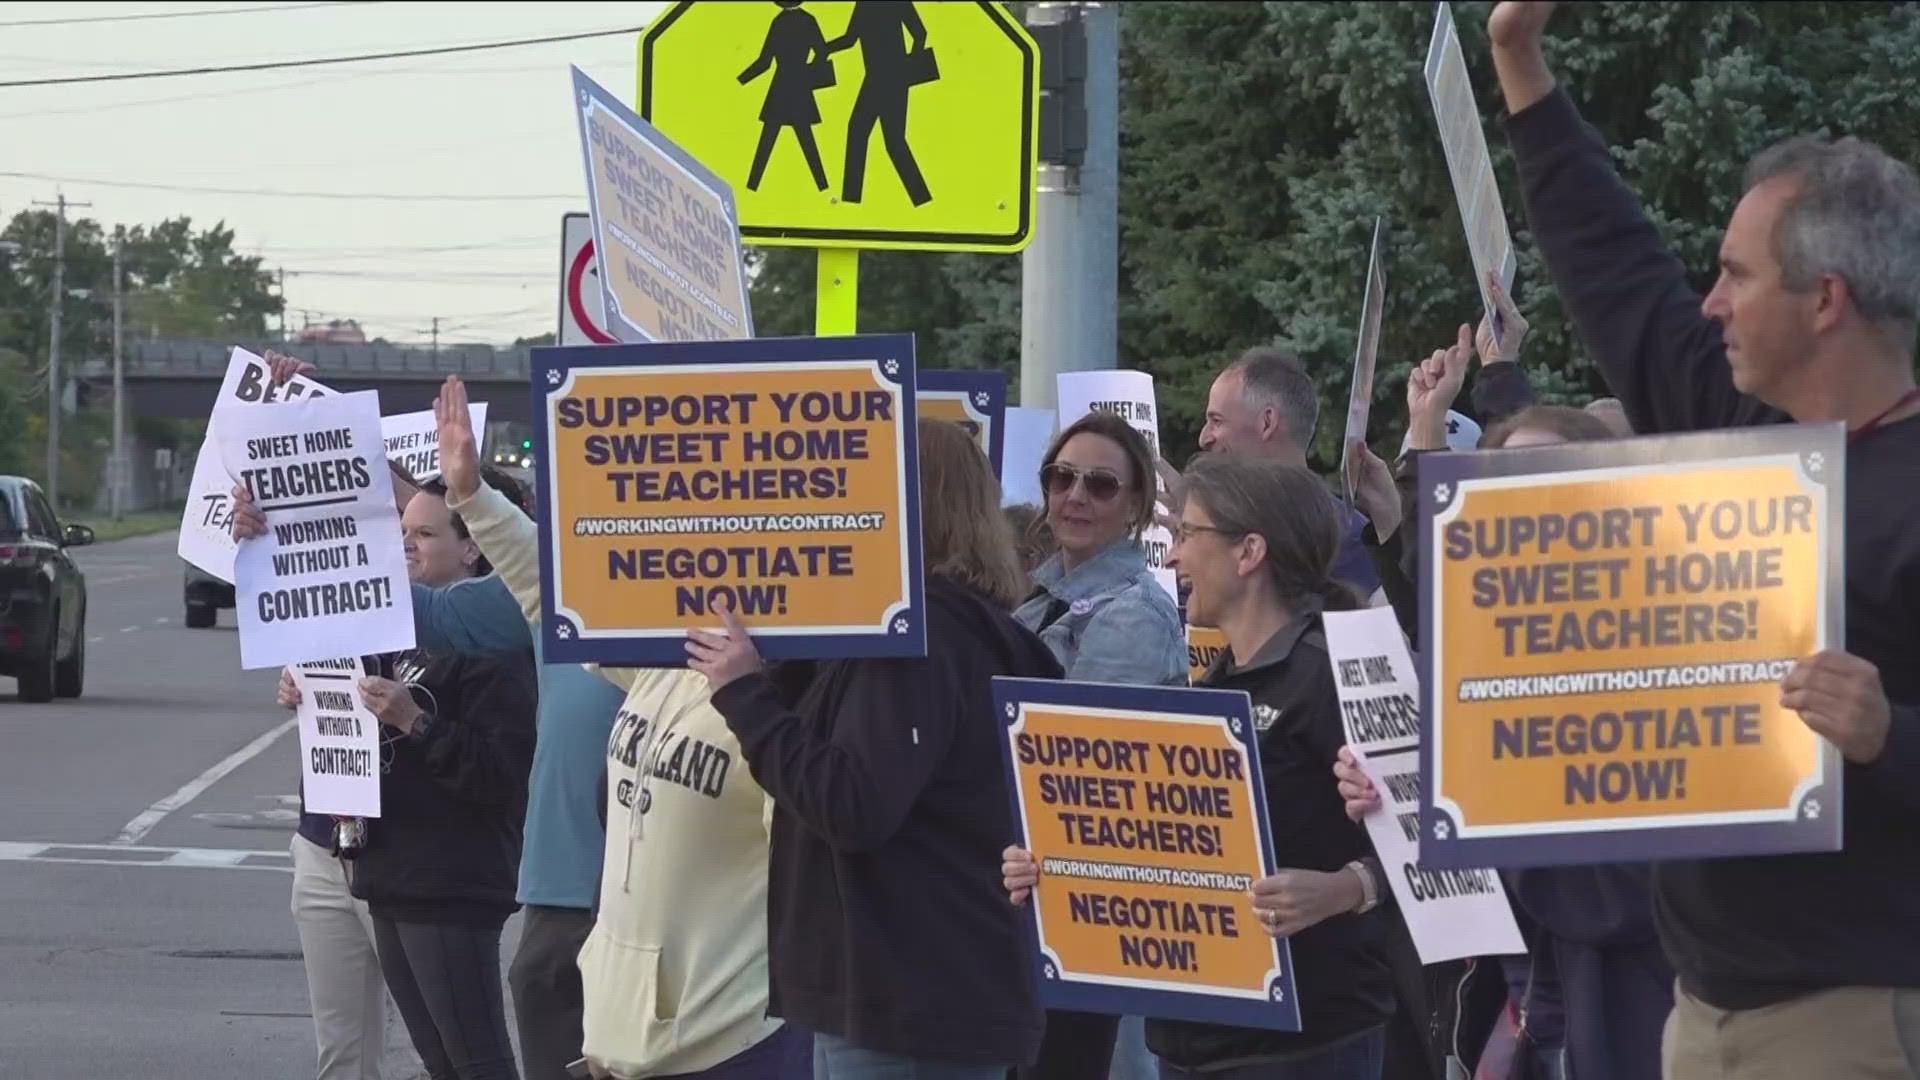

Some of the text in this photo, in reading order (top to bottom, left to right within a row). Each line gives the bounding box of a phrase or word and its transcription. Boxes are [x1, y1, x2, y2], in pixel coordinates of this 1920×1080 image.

[590, 119, 732, 248] SUPPORT YOUR
[604, 157, 727, 271] SWEET HOME
[616, 193, 722, 292] TEACHERS!
[558, 391, 893, 428] SUPPORT YOUR
[247, 428, 353, 460] SWEET HOME
[584, 429, 869, 466] SWEET HOME
[241, 457, 371, 499] TEACHERS
[607, 467, 847, 503] TEACHERS!
[275, 516, 357, 546] WORKING
[574, 513, 885, 536] #WORKINGWITHOUTACONTRACT
[1445, 494, 1813, 562] SUPPORT YOUR
[272, 543, 368, 577] WITHOUT A
[608, 545, 854, 580] NEGOTIATE
[1471, 547, 1784, 609] SWEET HOME
[257, 577, 393, 623] CONTRACT!
[676, 584, 787, 617] NOW!
[1495, 600, 1759, 658] TEACHERS!
[313, 690, 353, 711] WORKING
[1459, 659, 1796, 702] #WORKINGWITHOUTACONTRACT
[316, 716, 362, 738] WITHOUT A
[1343, 692, 1420, 744] TEACHERS
[1491, 703, 1762, 760] NEGOTIATE
[311, 747, 371, 777] CONTRACT!
[1017, 733, 1244, 781] SUPPORT YOUR
[1039, 773, 1233, 818] SWEET HOME
[1564, 758, 1687, 806] NOW!
[1058, 812, 1223, 857] TEACHERS!
[1043, 856, 1251, 892] #WORKINGWITHOUTACONTRACT
[1068, 892, 1239, 938] NEGOTIATE
[1119, 934, 1199, 973] NOW!
